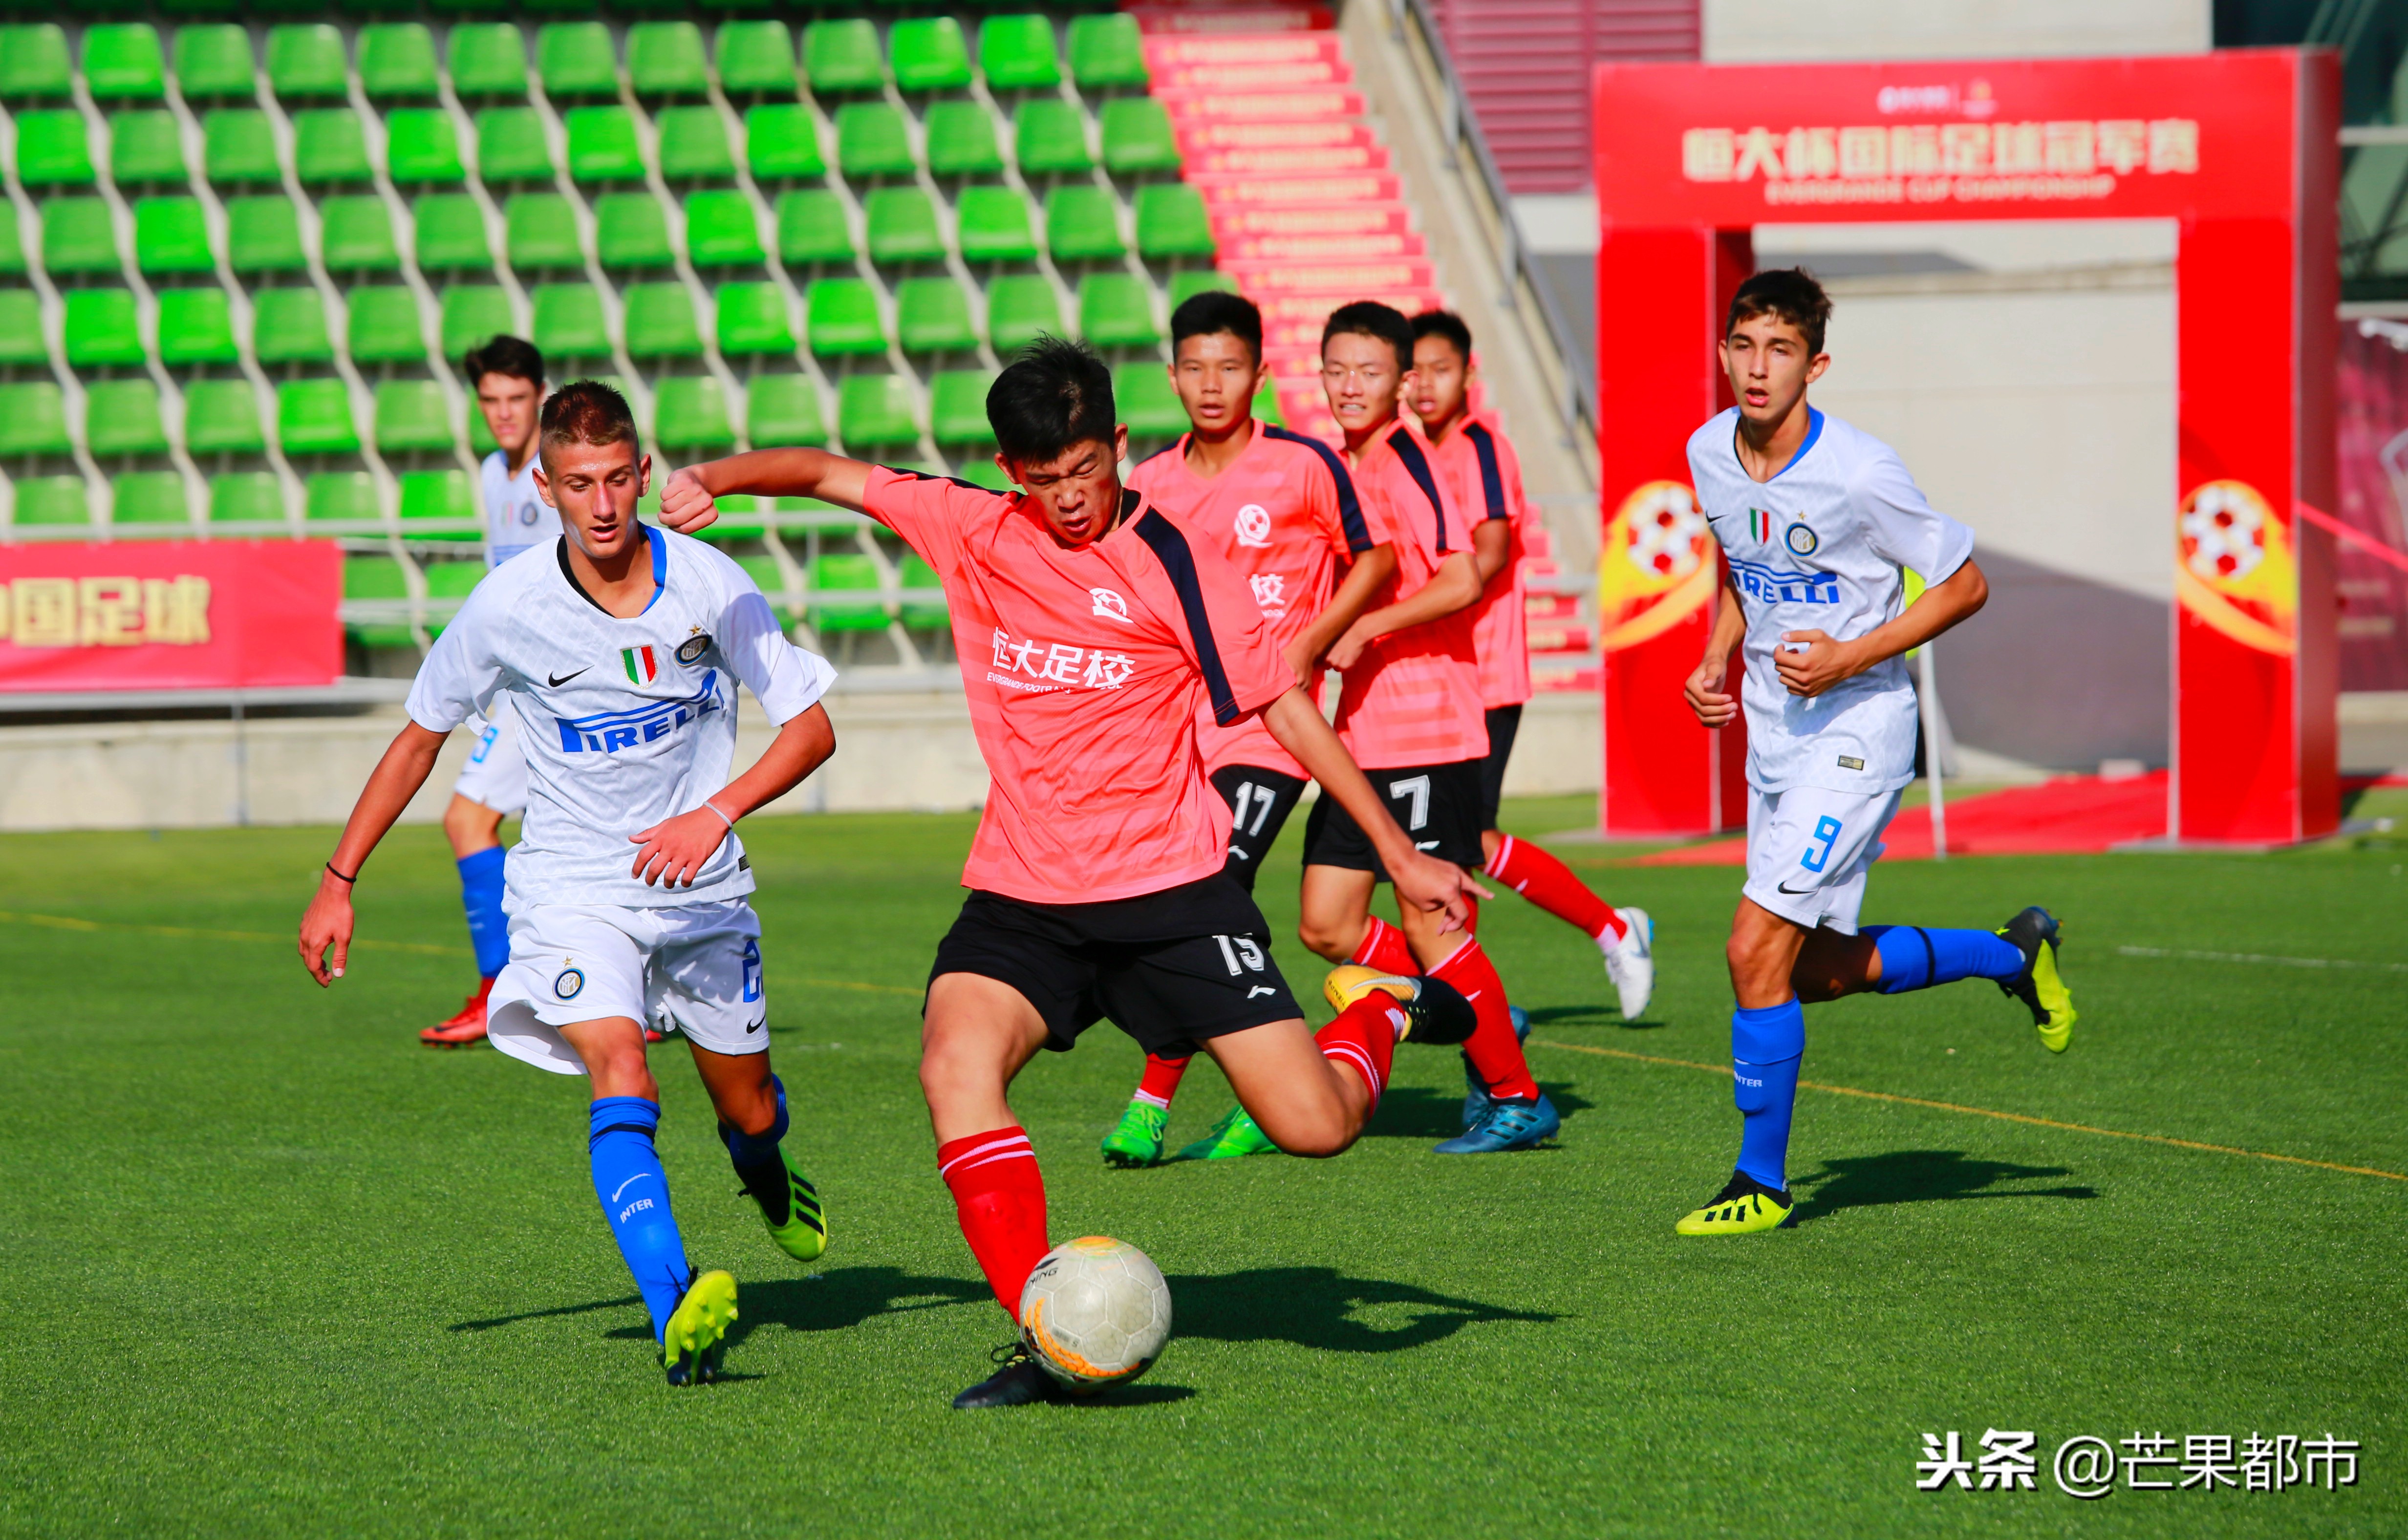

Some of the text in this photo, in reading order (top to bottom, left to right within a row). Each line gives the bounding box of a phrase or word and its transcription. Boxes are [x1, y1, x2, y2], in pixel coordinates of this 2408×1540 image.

[1682, 118, 2199, 182] 恒大杯国际足球冠军赛
[1727, 556, 1840, 603] IRELLI
[0, 575, 211, 646] 国足球
[992, 626, 1136, 688] 恒大足校
[555, 669, 724, 753] PIRELLI
[1233, 782, 1275, 836] 17
[1390, 775, 1430, 831] 7
[1800, 815, 1842, 872] 9
[742, 939, 764, 1003] 2
[1212, 933, 1265, 976] 15
[1734, 1070, 1763, 1087] INTER
[620, 1198, 654, 1223] INTER
